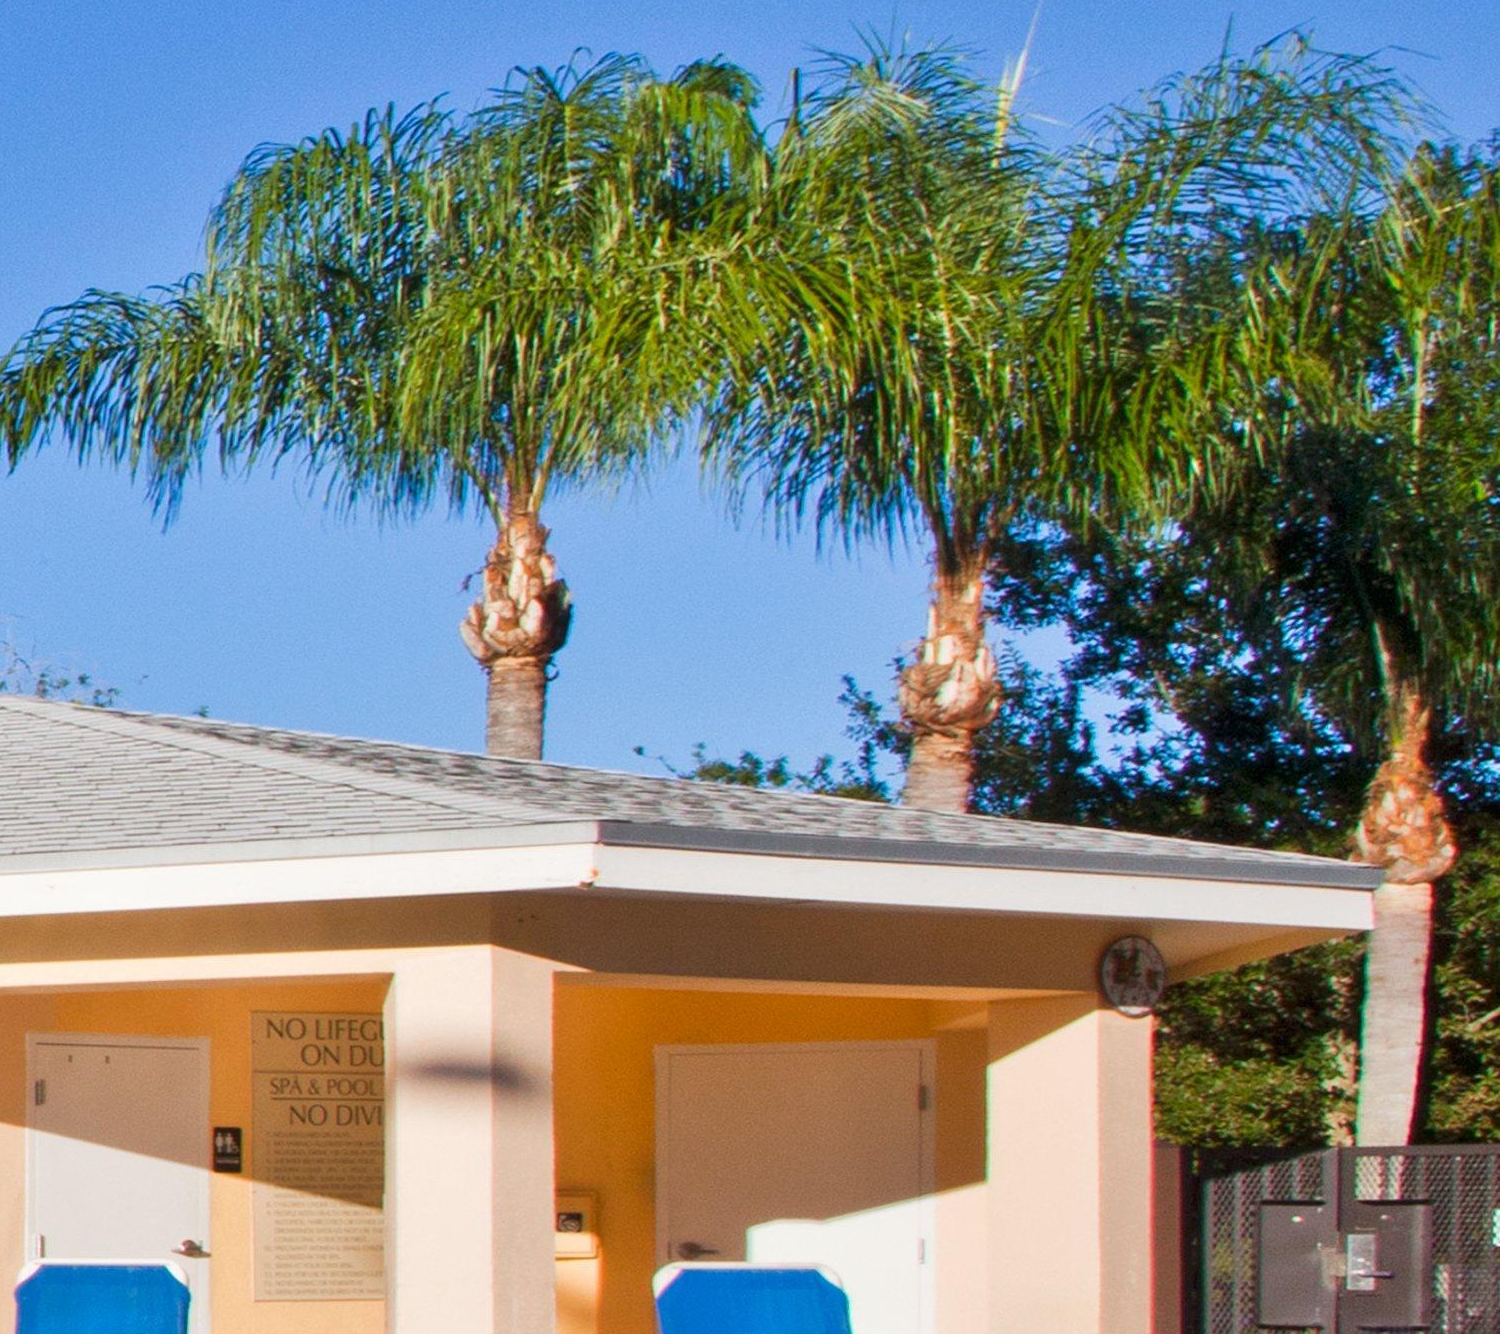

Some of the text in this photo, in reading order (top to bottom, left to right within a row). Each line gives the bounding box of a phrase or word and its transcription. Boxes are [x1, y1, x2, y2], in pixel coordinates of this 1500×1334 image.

[267, 1018, 384, 1041] NO LIFEG
[301, 1044, 340, 1066] ON
[269, 1077, 378, 1096] SPA & POOL
[289, 1104, 327, 1126] NO
